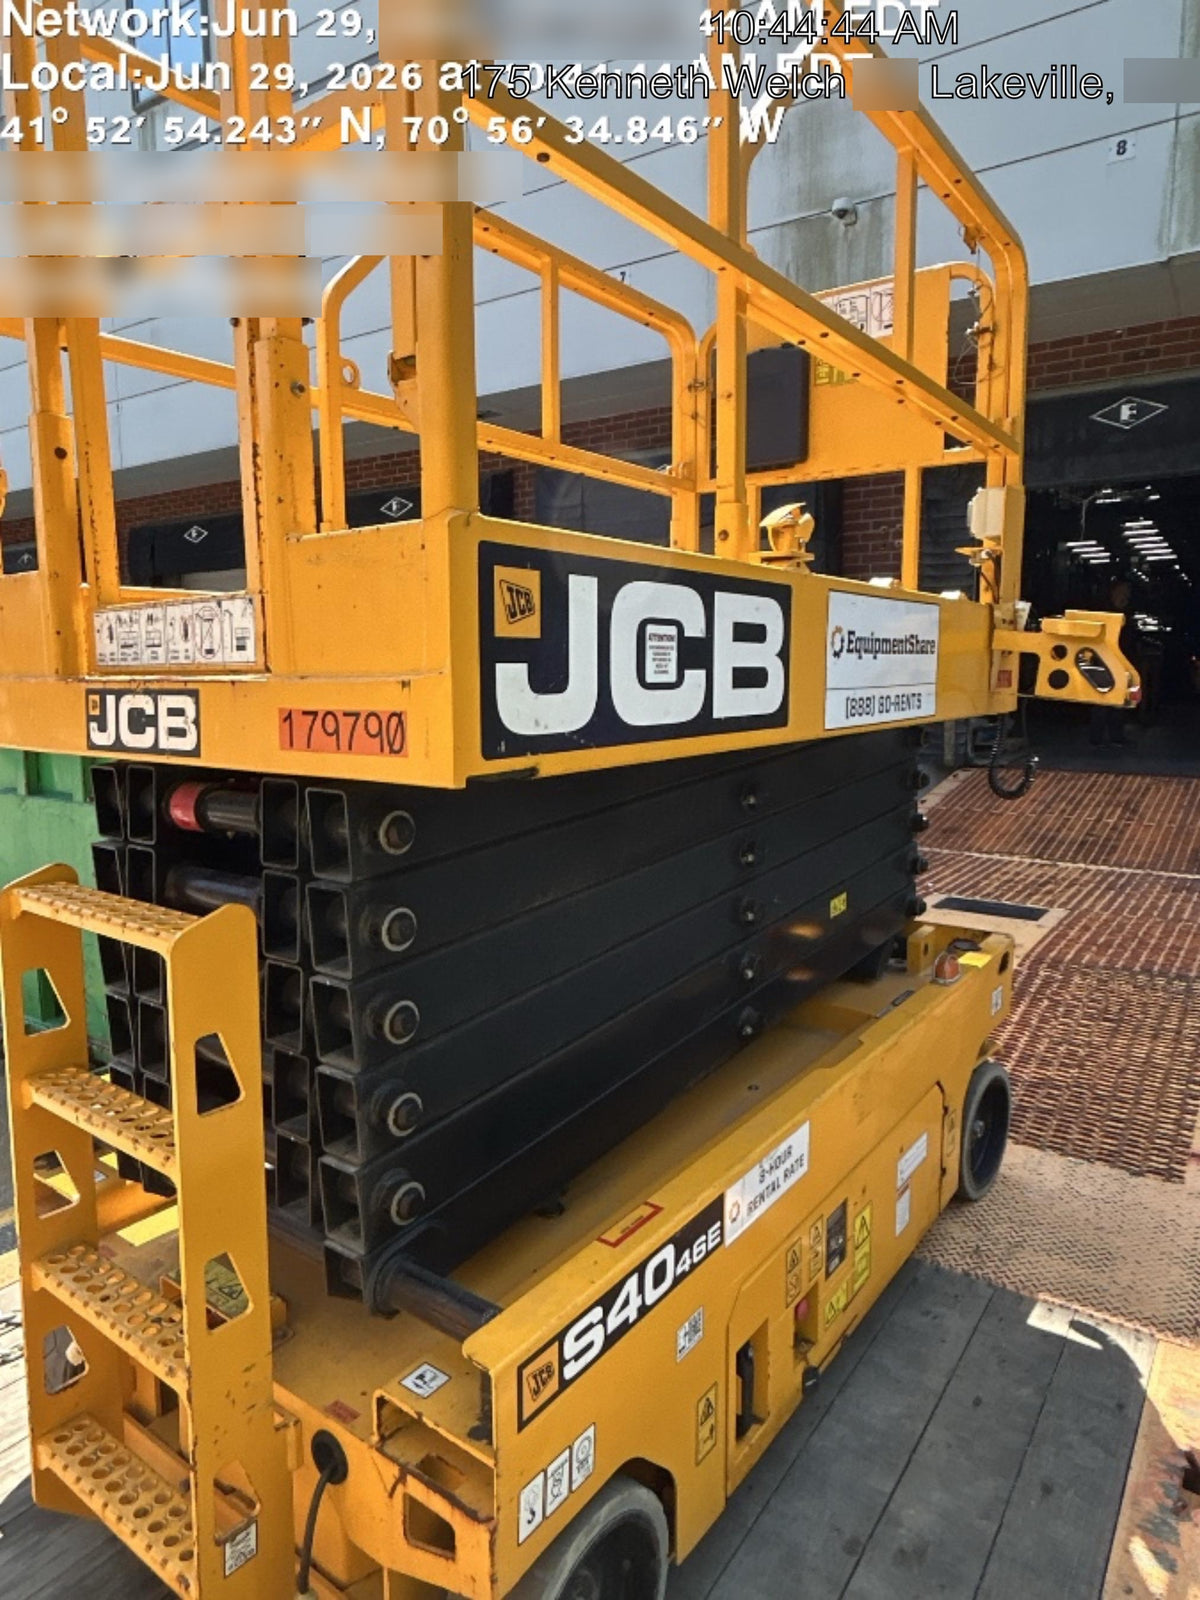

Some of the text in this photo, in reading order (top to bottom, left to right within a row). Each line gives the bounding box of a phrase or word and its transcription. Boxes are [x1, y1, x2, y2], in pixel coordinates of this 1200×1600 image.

[1116, 139, 1128, 156] 8
[506, 581, 536, 619] JCB
[495, 573, 785, 735] JCB
[846, 630, 936, 660] EquipmentShare
[89, 694, 198, 751] JCB
[282, 709, 407, 754] 179790
[747, 1153, 805, 1217] RENTAL RATE
